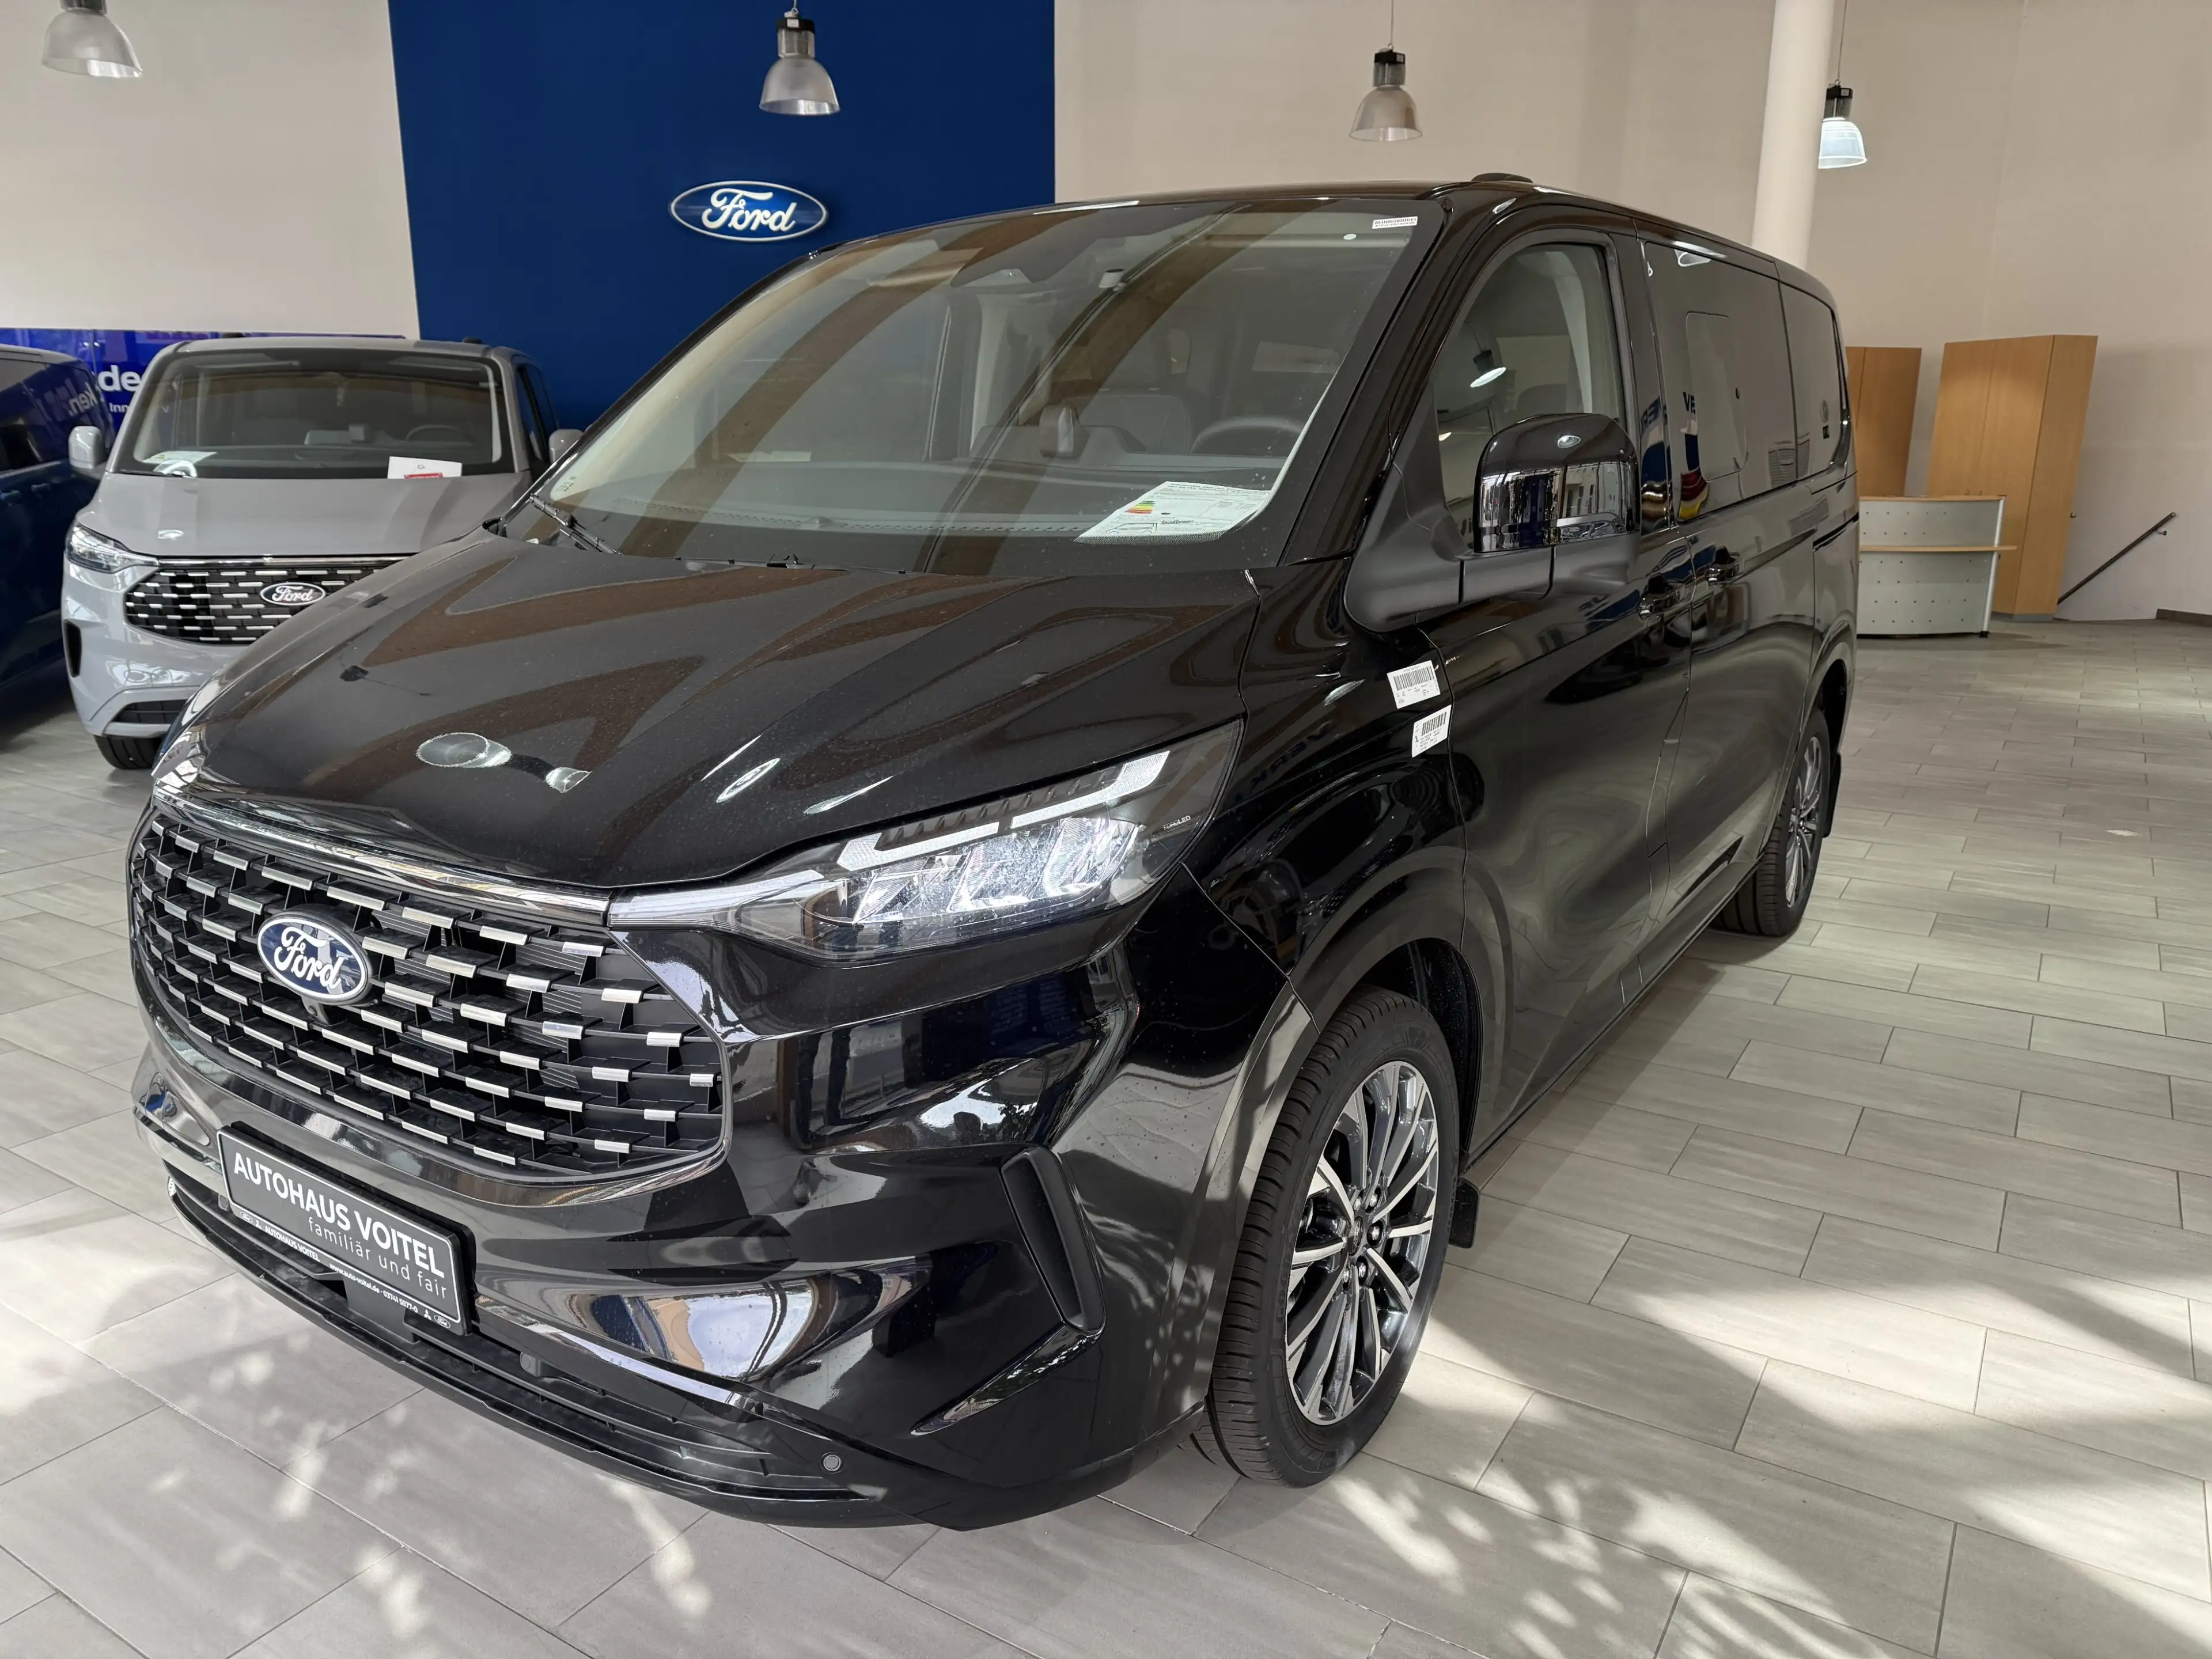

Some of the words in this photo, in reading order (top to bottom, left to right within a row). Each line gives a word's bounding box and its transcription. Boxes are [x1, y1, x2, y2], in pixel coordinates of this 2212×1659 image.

[701, 188, 797, 231] Ford
[271, 585, 314, 601] Ford
[274, 926, 346, 990] Ford
[234, 1152, 351, 1231] AUTOHAUS
[354, 1210, 445, 1278] VOITEL
[265, 1225, 298, 1249] AUTOHAUS
[297, 1243, 321, 1262] VOITEL
[308, 1216, 370, 1260] familiär
[378, 1255, 410, 1281] und
[417, 1271, 446, 1298] fair
[329, 1263, 380, 1294] www.auto-voitel.de
